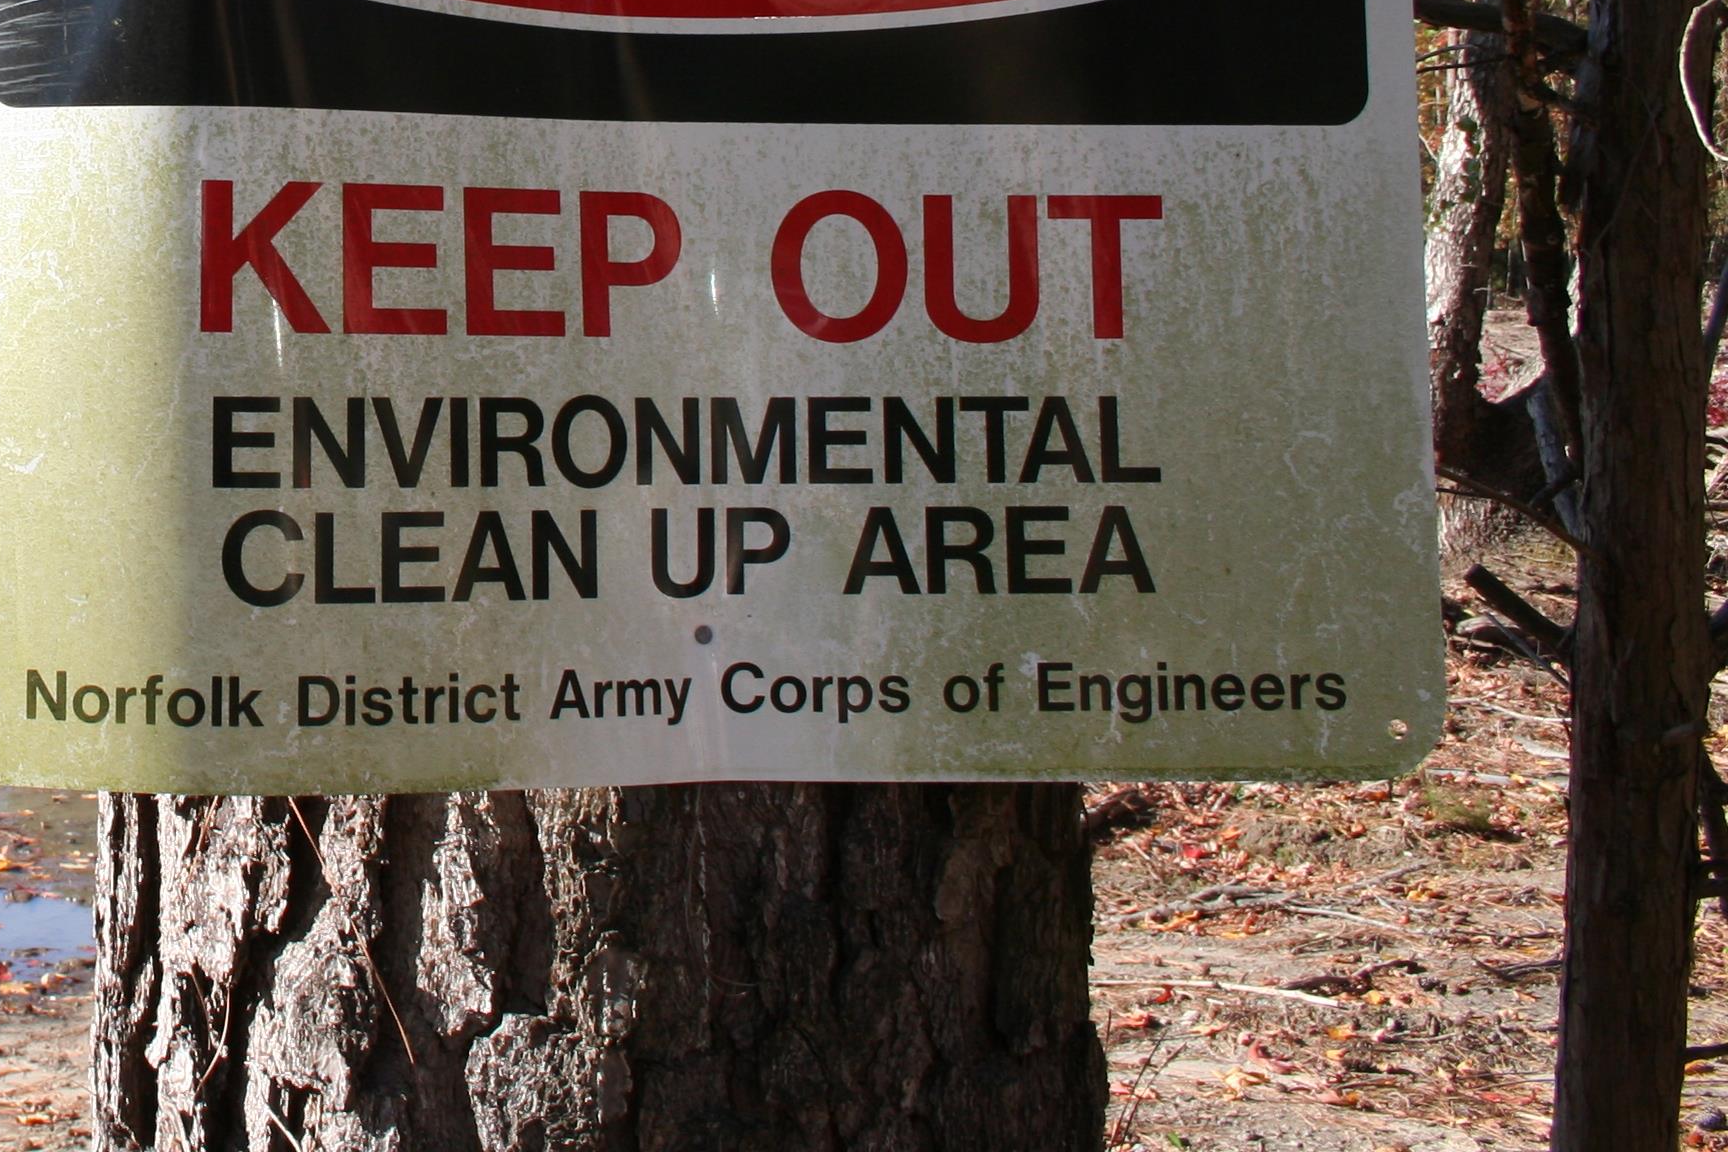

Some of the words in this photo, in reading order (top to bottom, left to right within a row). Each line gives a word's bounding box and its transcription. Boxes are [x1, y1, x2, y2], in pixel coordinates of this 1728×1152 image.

[203, 181, 680, 336] KEEP
[773, 192, 1160, 341] OUT
[213, 395, 1161, 488] ENVIRONMENTAL
[222, 510, 598, 607] CLEAN
[652, 508, 790, 598] UP
[843, 506, 1156, 595] AREA
[24, 669, 264, 727] Norfolk
[298, 673, 520, 727] District
[550, 670, 691, 725] Army
[722, 663, 910, 723] Corps
[944, 663, 1005, 713] of
[1038, 662, 1347, 724] Engineers
